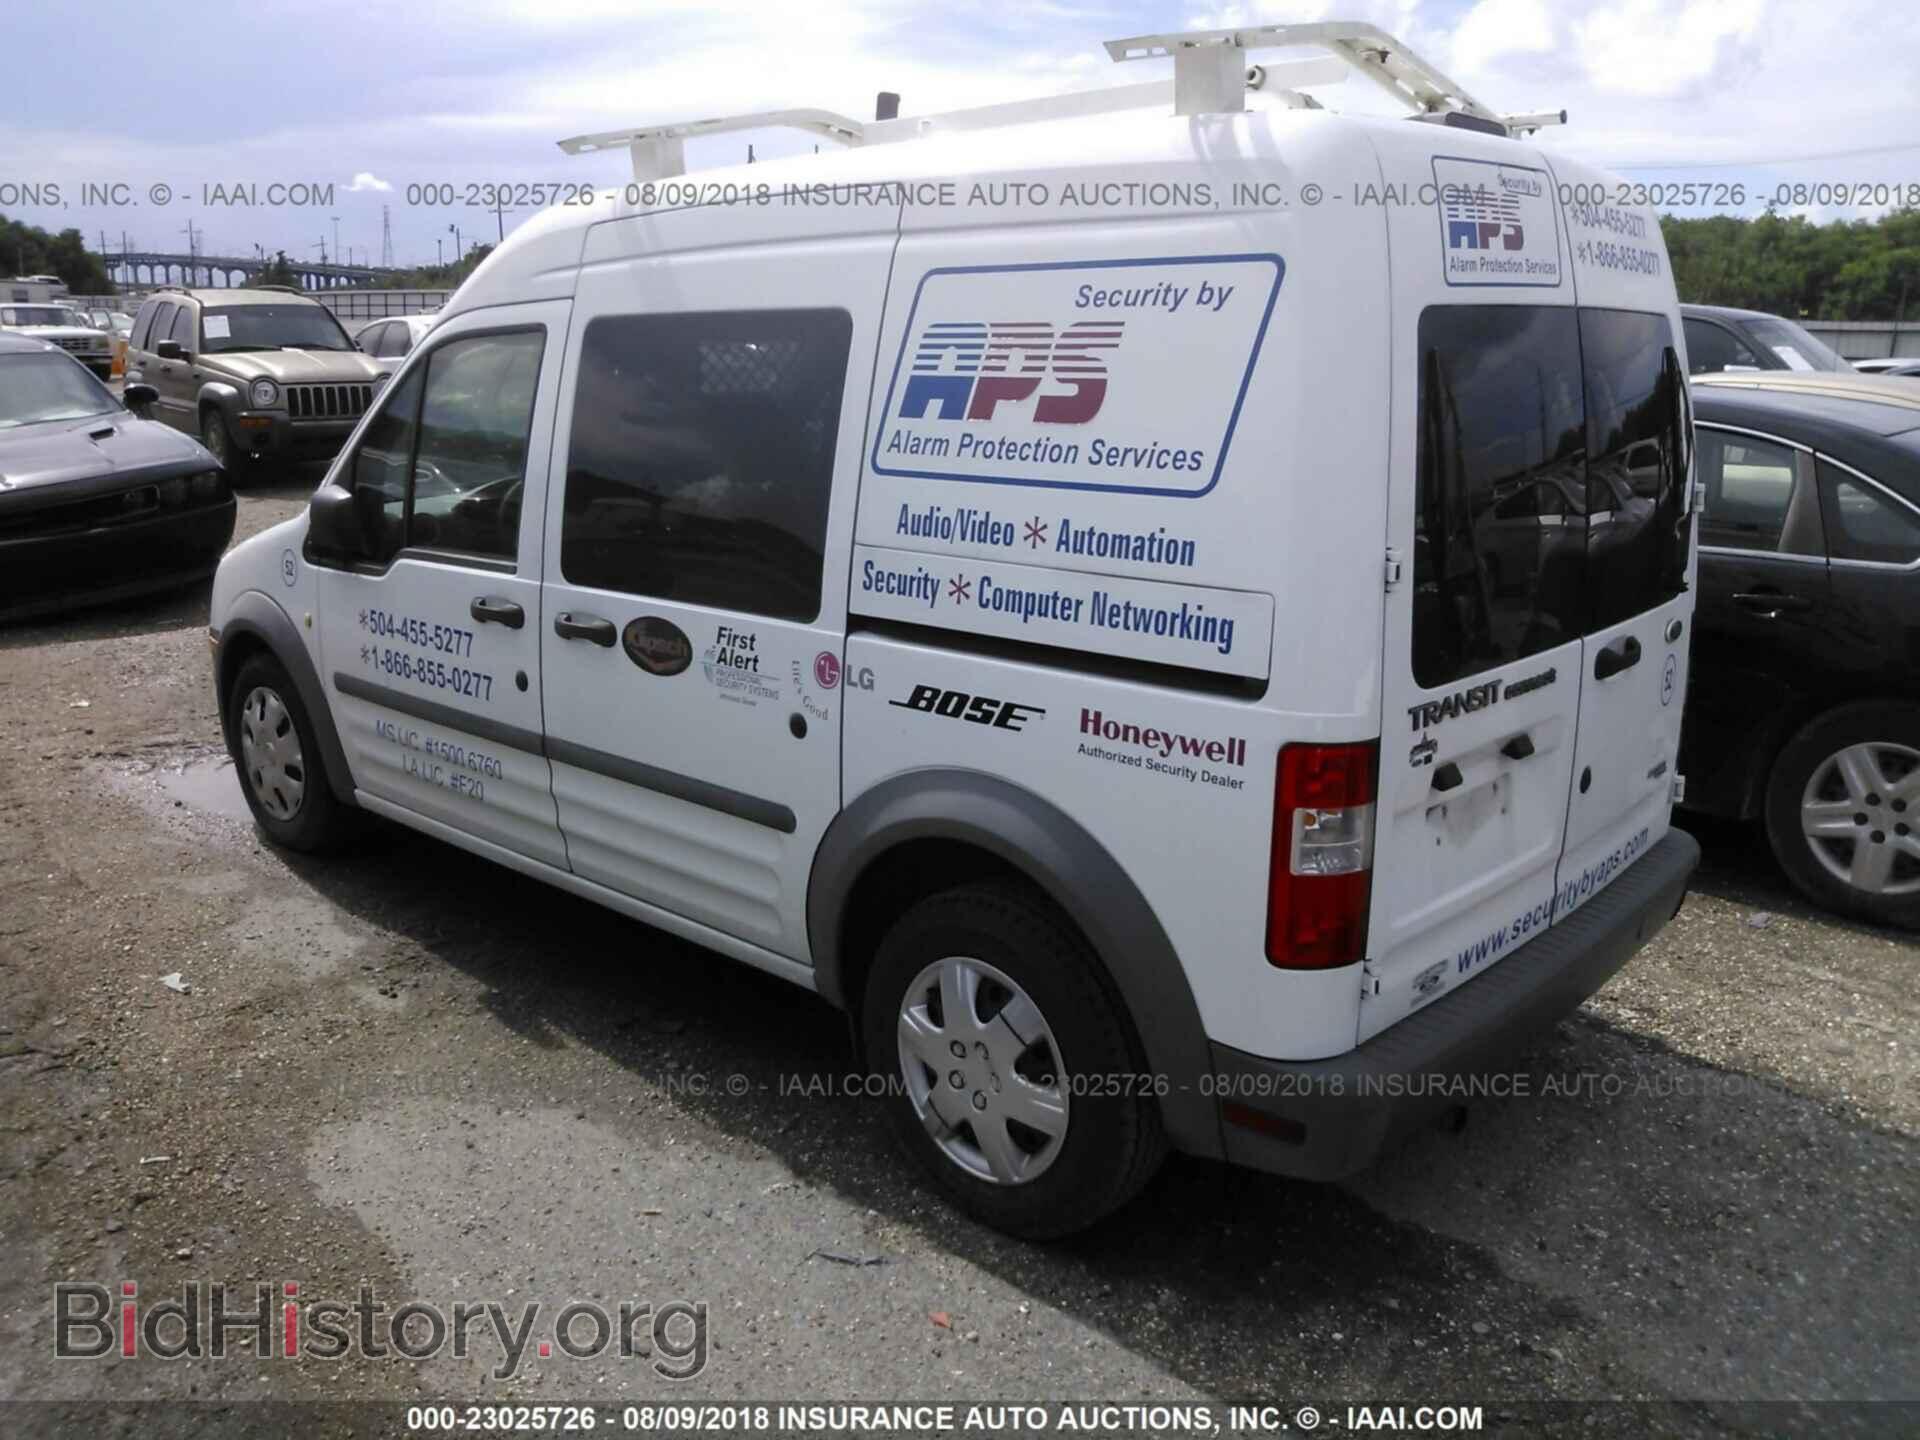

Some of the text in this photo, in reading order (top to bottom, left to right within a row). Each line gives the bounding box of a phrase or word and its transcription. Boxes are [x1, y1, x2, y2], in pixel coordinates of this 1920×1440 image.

[1450, 256, 1557, 275] Alarm Protection Services
[1074, 281, 1233, 313] Security by
[887, 429, 1204, 471] Alarm Protection Services
[896, 504, 1195, 567] Audio/Video Automation
[862, 560, 1235, 655] Security Computer Networking
[716, 626, 756, 651] First
[716, 648, 759, 673] Alert
[846, 664, 875, 692] LG
[888, 684, 1047, 733] BOSE
[1407, 679, 1503, 731] TRANSIT
[1079, 707, 1247, 767] Honeywell
[1077, 743, 1246, 790] Authorized Security Dealer
[1457, 827, 1650, 973] www.securitybyaps.com
